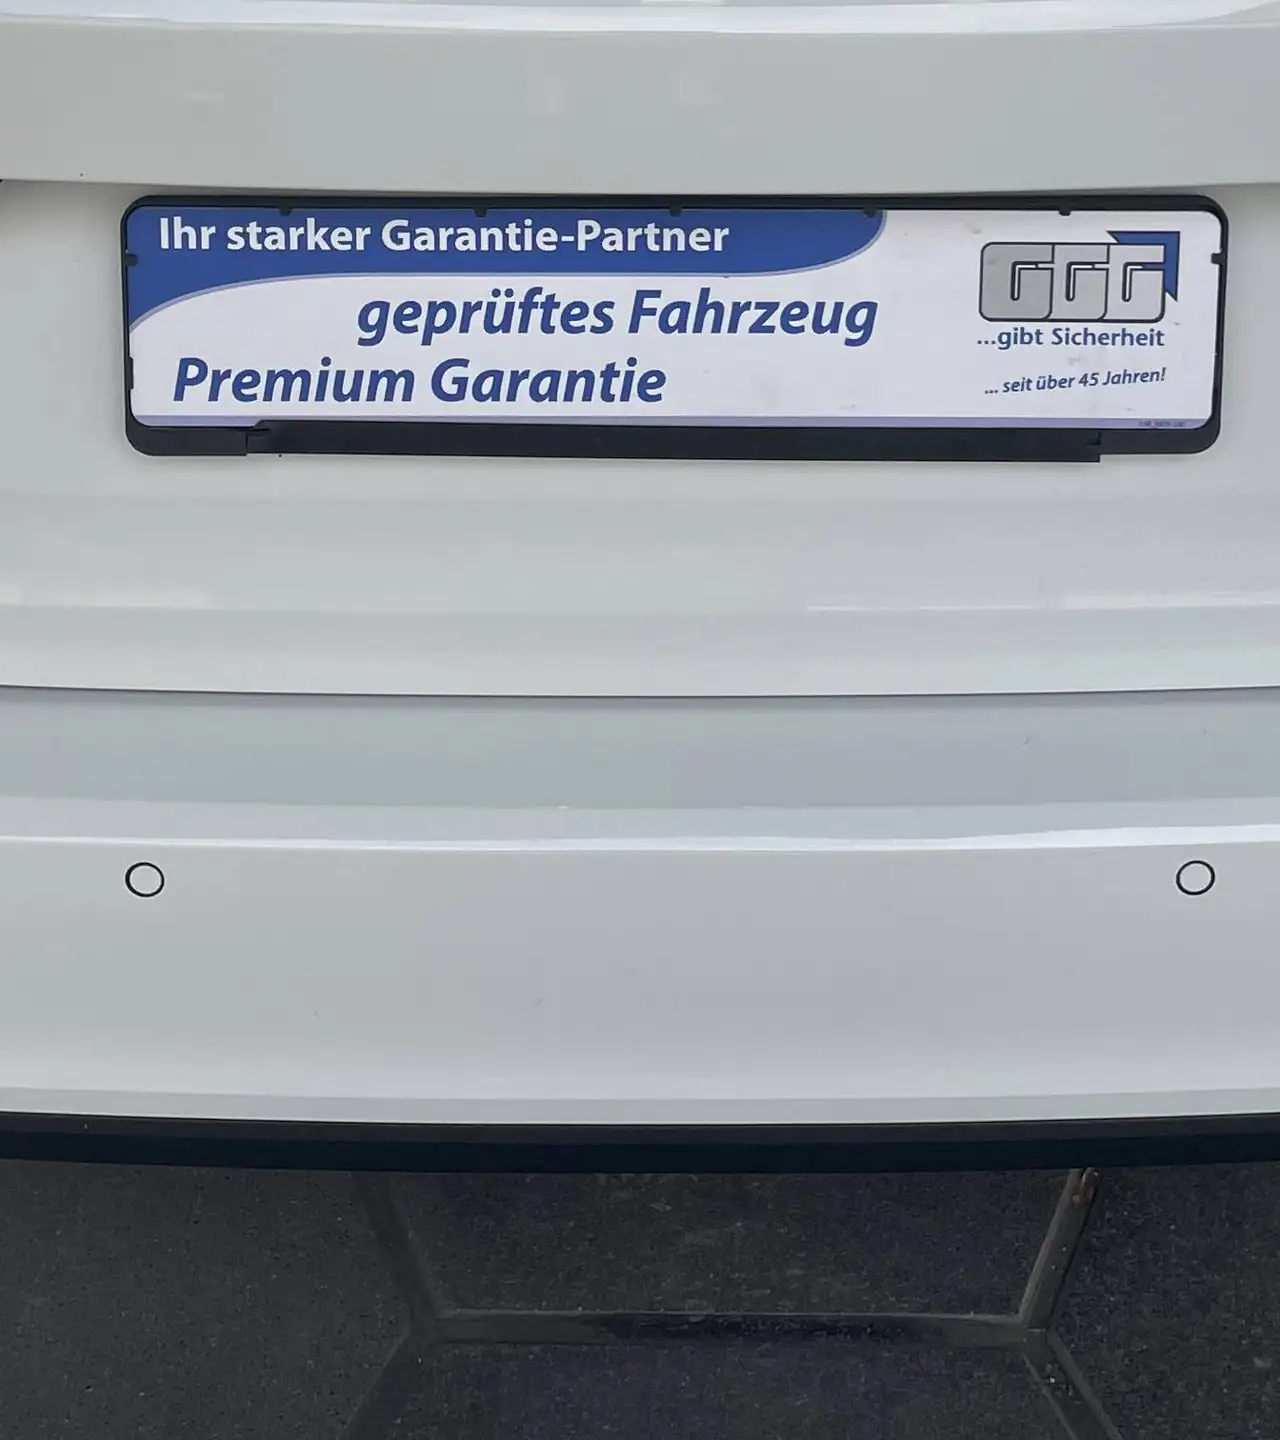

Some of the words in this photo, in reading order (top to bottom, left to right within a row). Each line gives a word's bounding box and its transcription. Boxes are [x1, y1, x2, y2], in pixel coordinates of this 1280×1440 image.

[159, 215, 216, 250] Ihr
[226, 216, 371, 252] starker
[381, 217, 730, 253] Garantie-Partner
[356, 286, 616, 347] geprüftes
[628, 286, 878, 347] Fahrzeug
[1051, 327, 1165, 347] Sicherheit
[173, 356, 415, 403] Premium
[431, 356, 667, 404] Garantie
[1002, 377, 1032, 394] seit
[1035, 375, 1075, 391] über
[1078, 371, 1099, 387] 45
[1102, 366, 1167, 387] Jahren!
